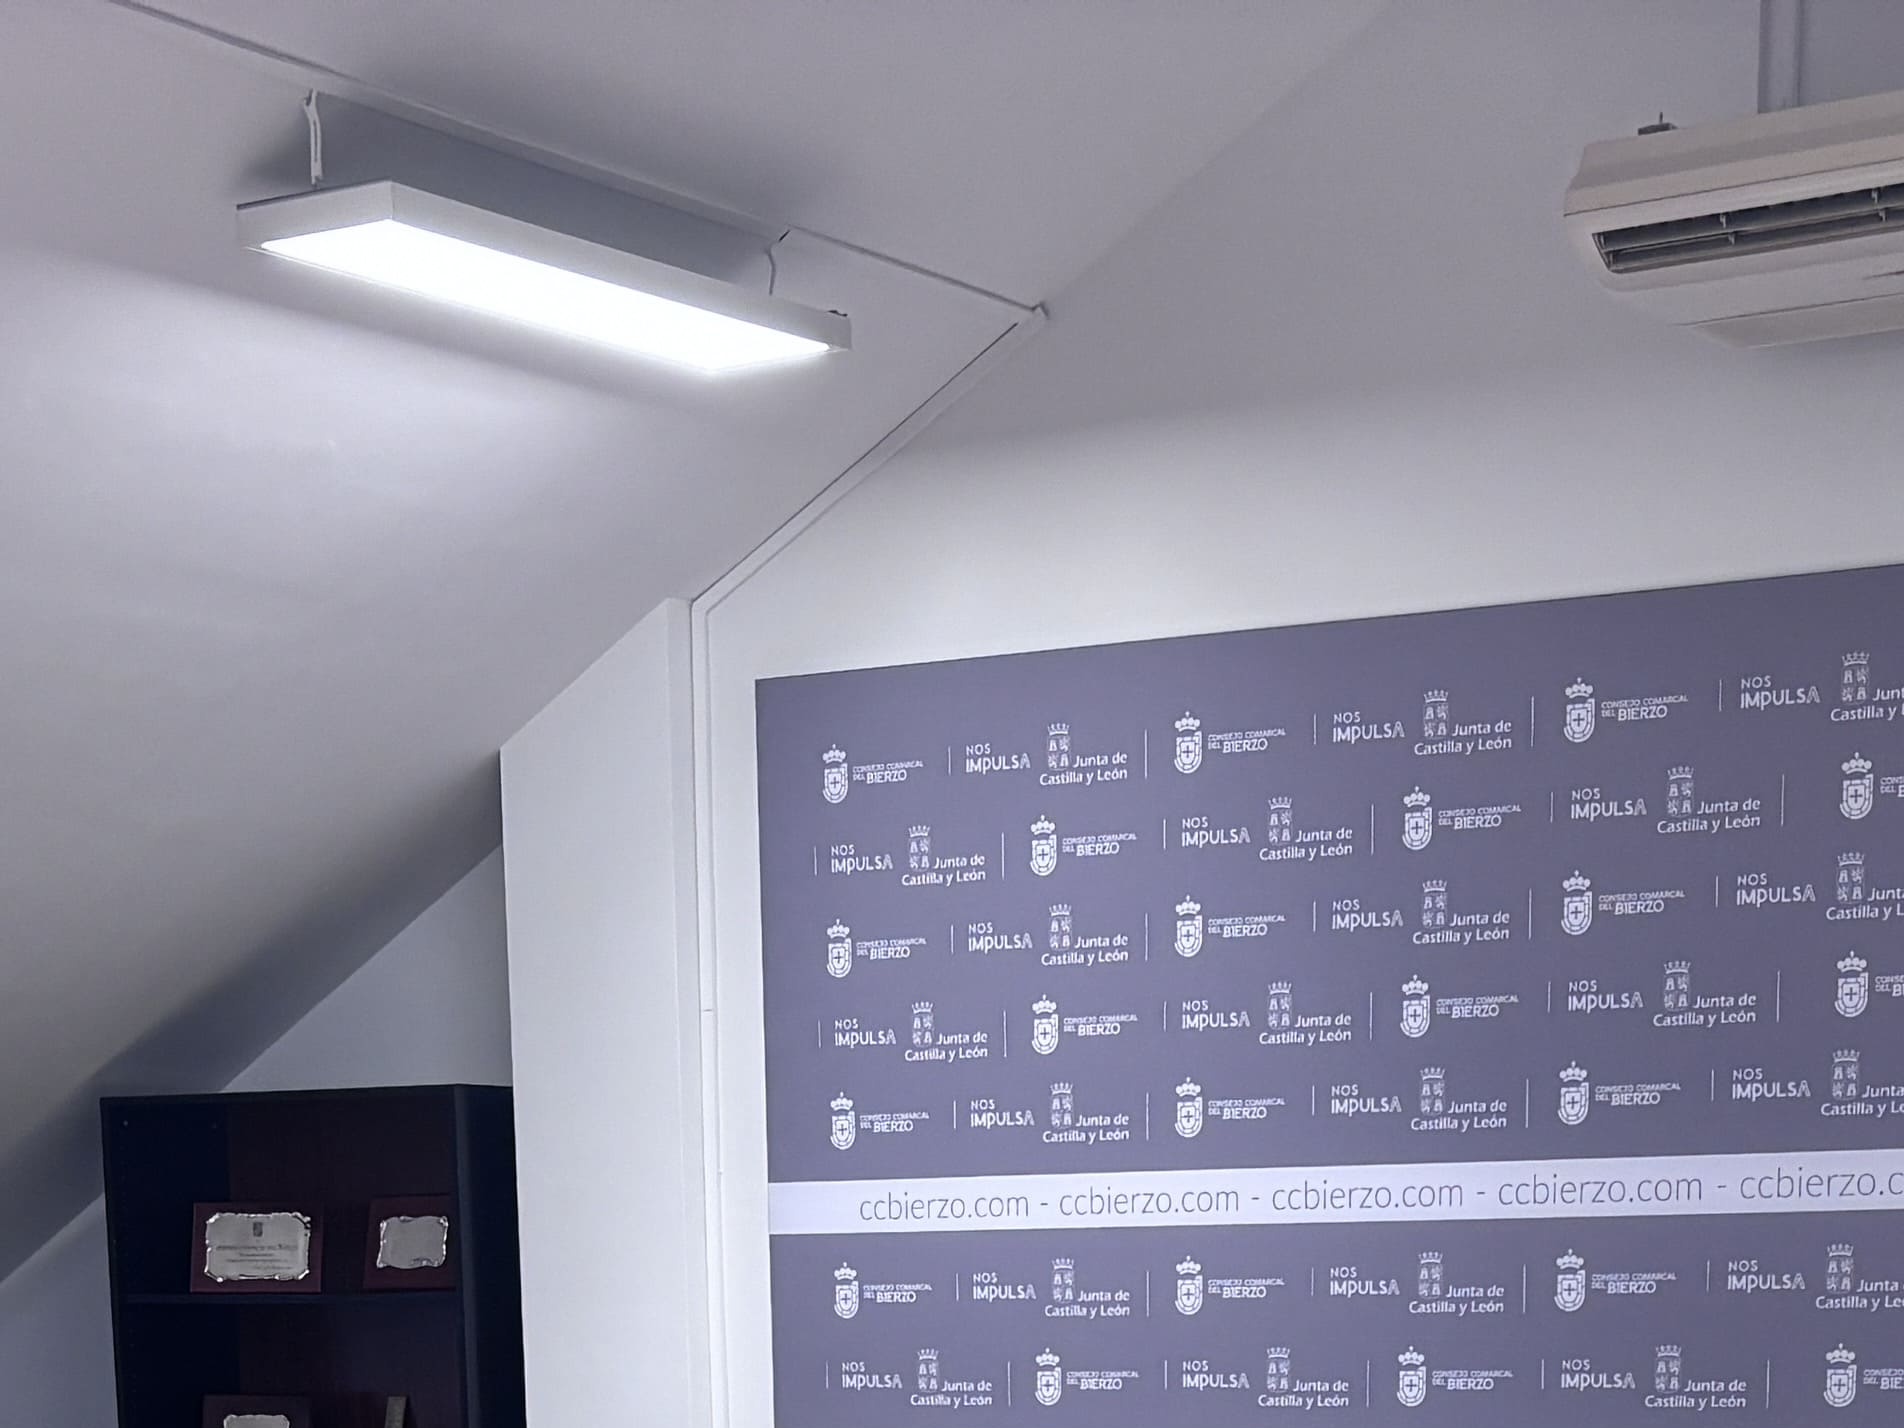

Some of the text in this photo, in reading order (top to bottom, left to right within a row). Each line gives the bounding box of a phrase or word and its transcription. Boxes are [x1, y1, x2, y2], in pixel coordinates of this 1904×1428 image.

[1740, 675, 1772, 690] NOS
[1740, 685, 1821, 711] IMPULSA
[1830, 705, 1884, 722] Castilla
[1887, 706, 1897, 721] y
[965, 742, 991, 757] NOS
[1222, 737, 1268, 754] BIERZO
[965, 752, 1031, 775] IMPULSA
[1072, 751, 1128, 768] Junta de
[1039, 767, 1128, 786] Castilla y León
[1182, 816, 1209, 829] NOS
[1453, 814, 1502, 830] BIERZO
[1181, 827, 1251, 849] IMPULSA
[1295, 827, 1353, 843] Junta de
[1259, 842, 1353, 862] Castilla y León
[1614, 899, 1665, 916] BIERZO
[1732, 1067, 1763, 1081] NOS
[1732, 1080, 1811, 1102] IMPULSA
[1861, 1085, 1904, 1099] Junta
[1820, 1102, 1874, 1116] Castilla
[1876, 1103, 1887, 1118] y
[859, 1191, 1030, 1221] ccbierzo.com
[1059, 1186, 1240, 1216] ccbierzo.com
[1272, 1179, 1464, 1211] ccbierzo.com
[1498, 1173, 1703, 1206] ccbierzo.com
[1222, 1285, 1267, 1299] BIERZO
[1182, 1359, 1209, 1372] NOS
[1182, 1372, 1250, 1391] IMPULSA
[1292, 1379, 1349, 1392] Junta de
[1257, 1394, 1349, 1411] Castilla y León
